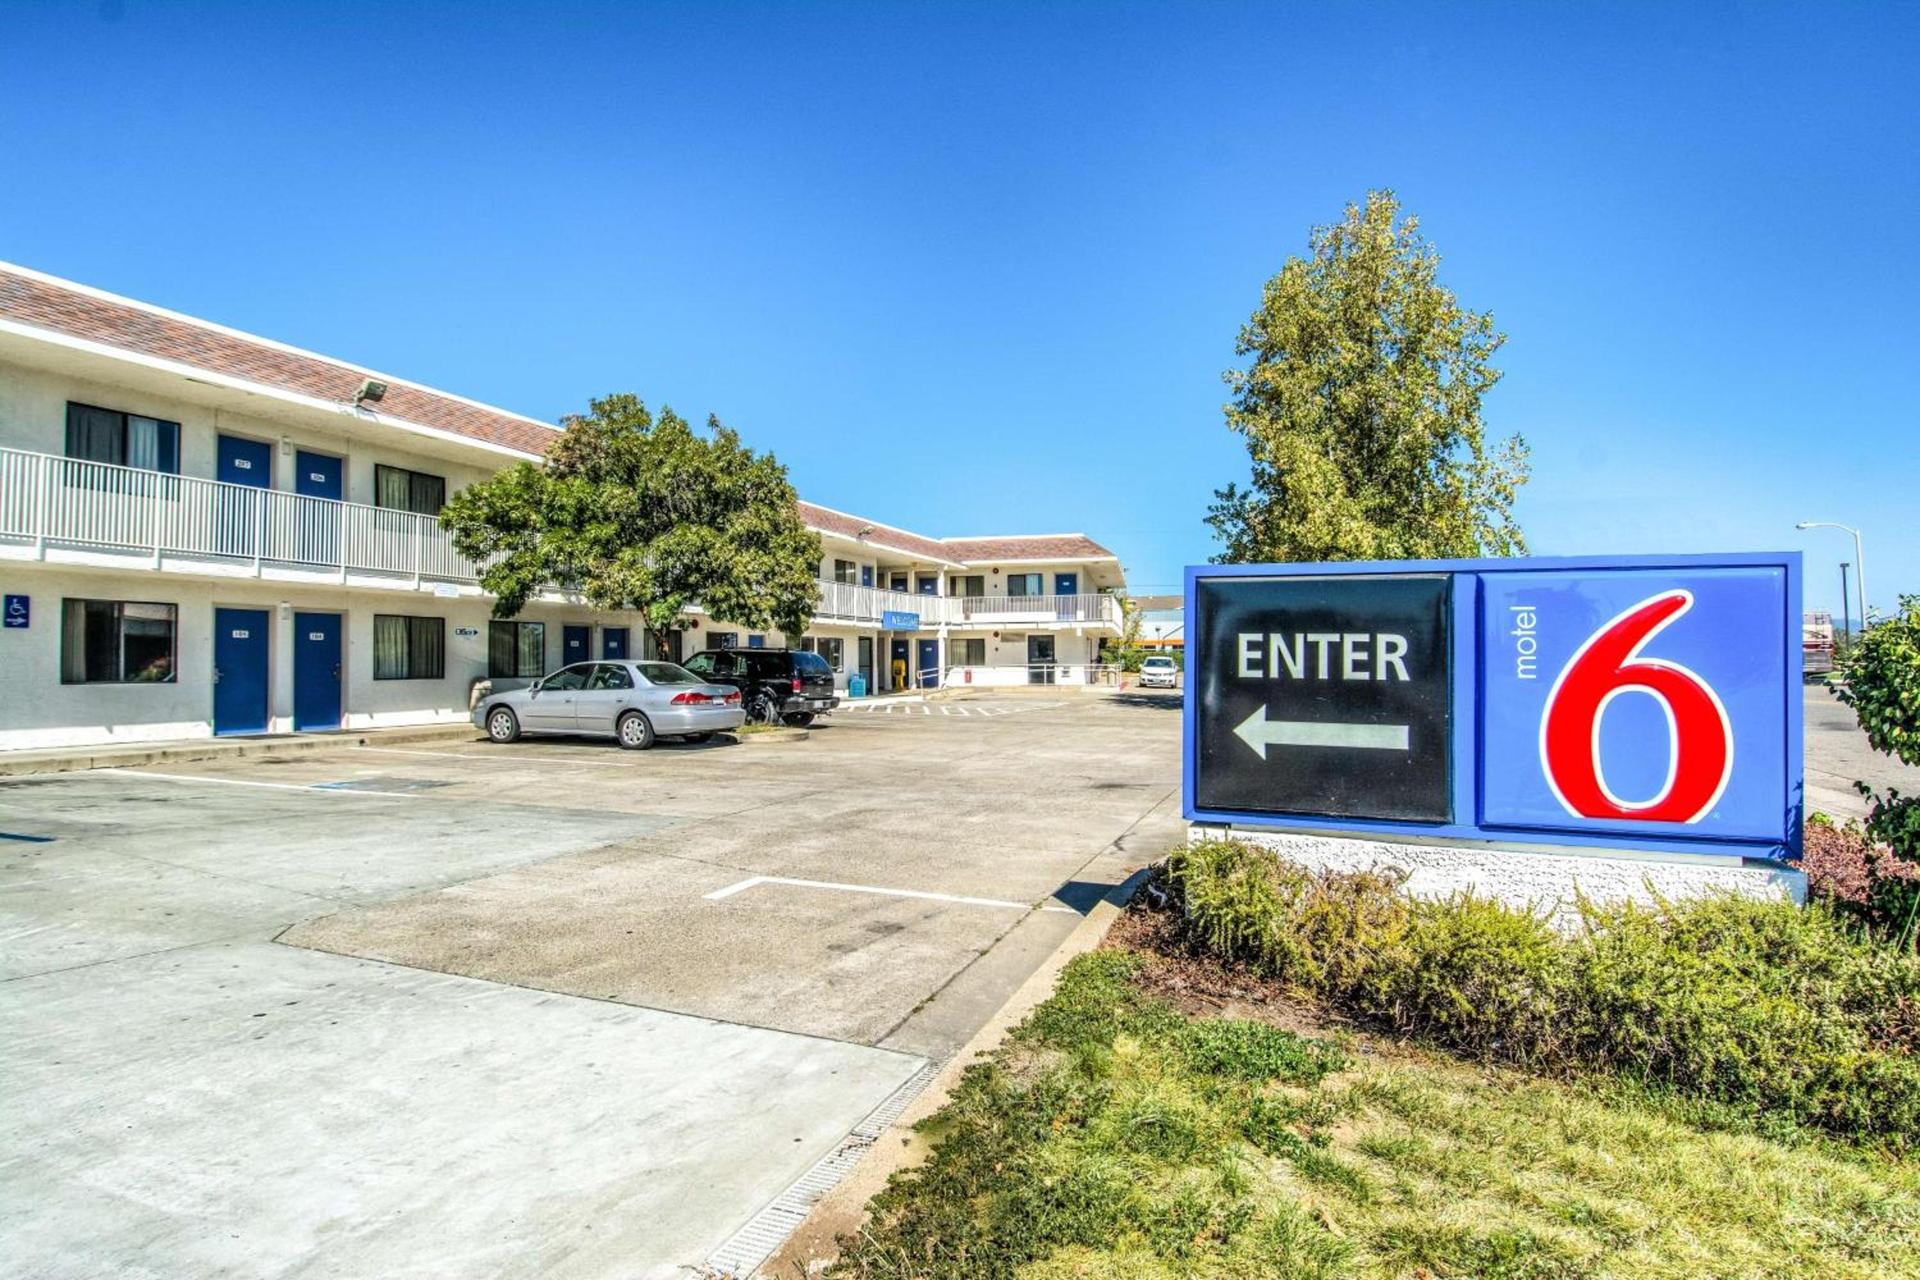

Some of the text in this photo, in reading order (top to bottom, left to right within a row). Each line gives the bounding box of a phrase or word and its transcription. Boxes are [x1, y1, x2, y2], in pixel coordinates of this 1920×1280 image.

[1238, 633, 1410, 681] ENTER
[1510, 589, 1734, 823] motel 6
